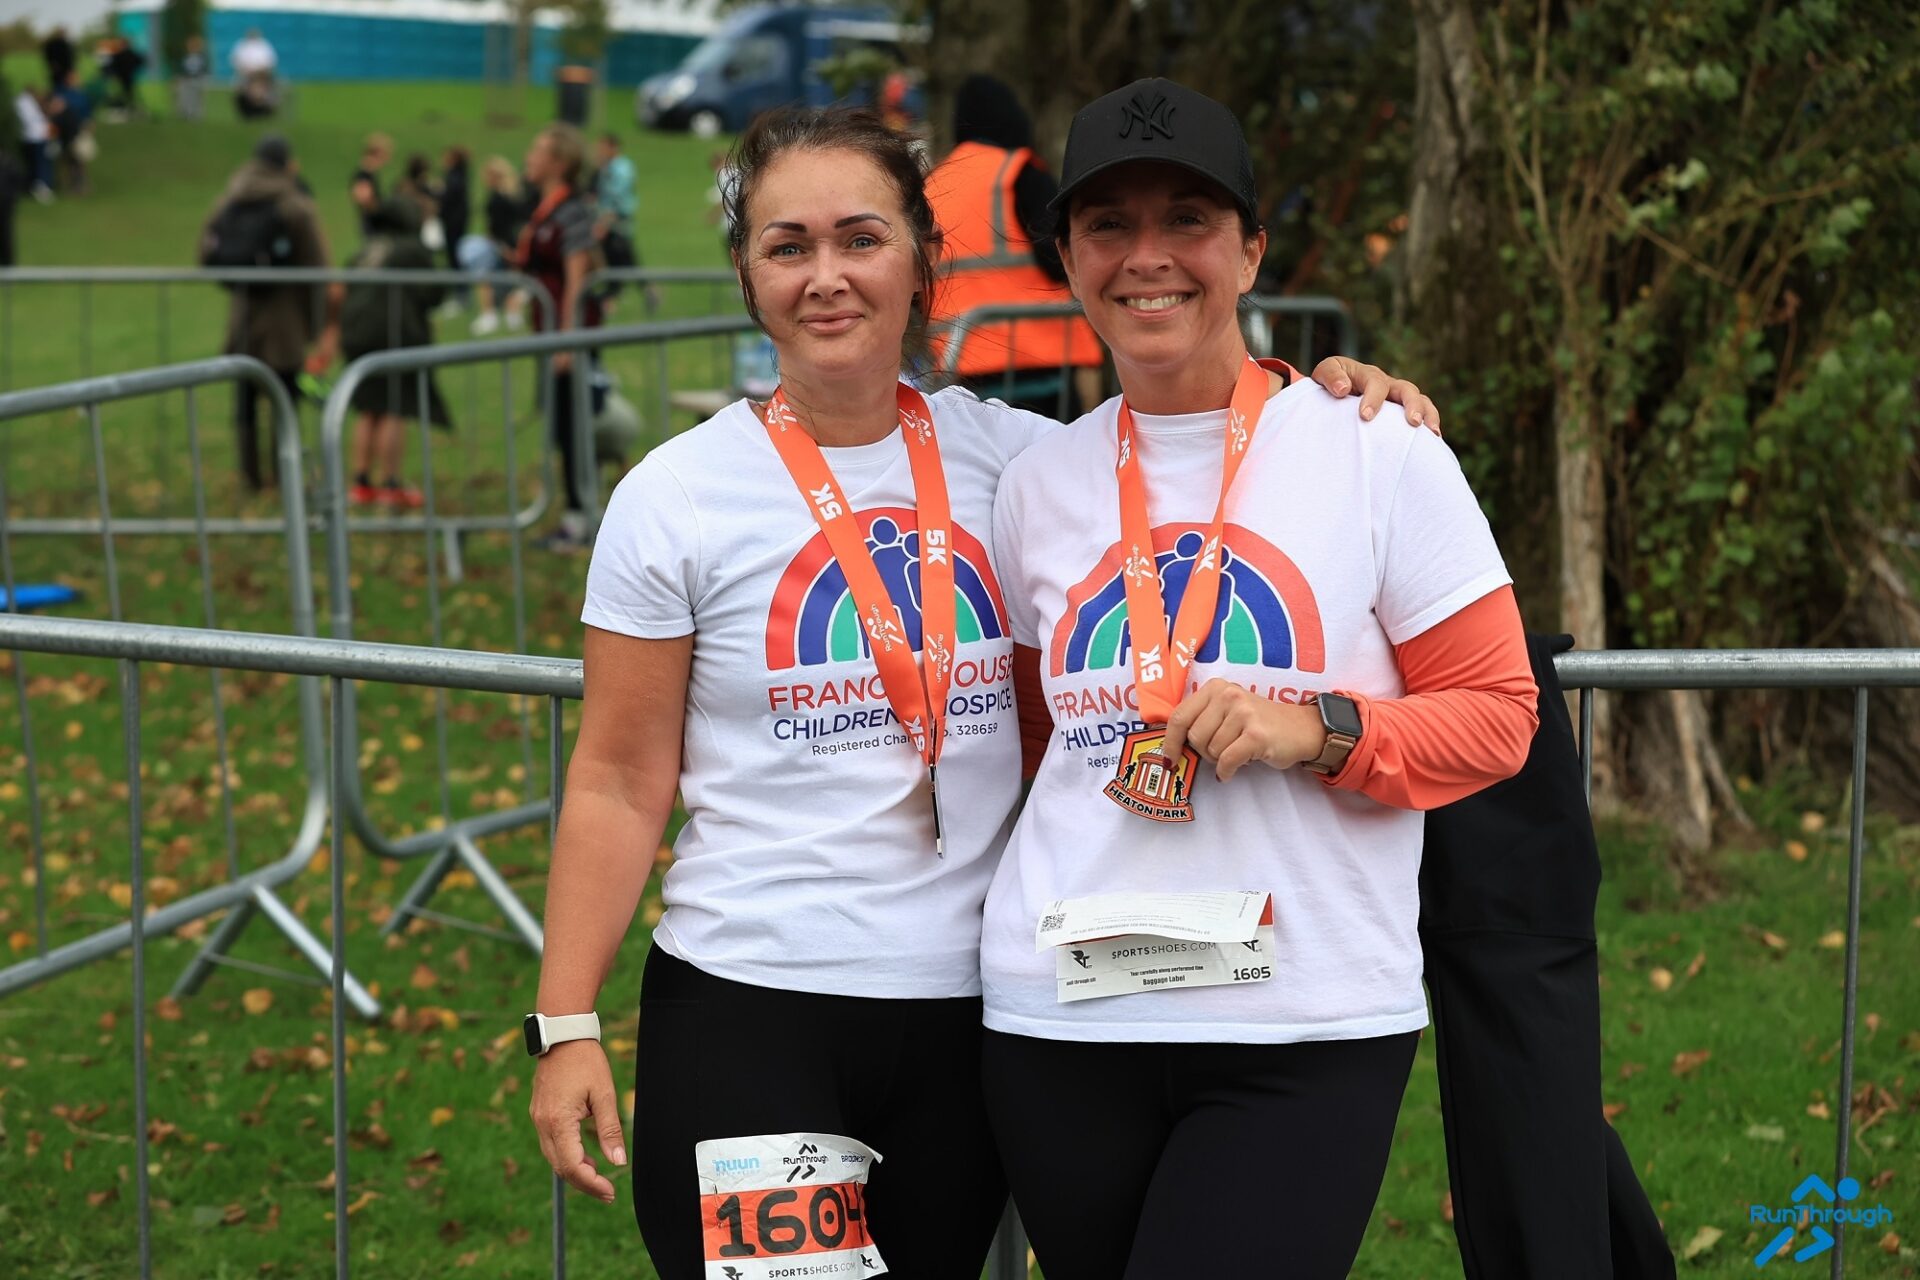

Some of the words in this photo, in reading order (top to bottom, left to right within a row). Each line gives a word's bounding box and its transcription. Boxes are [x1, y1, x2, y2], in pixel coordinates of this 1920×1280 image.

[1119, 91, 1176, 140] NY
[809, 482, 843, 521] 5K
[926, 528, 947, 566] 5K
[1195, 536, 1218, 575] 5K
[871, 603, 892, 653] RunThrough
[936, 633, 944, 683] RunThrough
[1139, 643, 1164, 683] 5K
[768, 673, 888, 712] FRANC
[954, 653, 1013, 688] OUSE
[1052, 684, 1140, 720] FRANC
[773, 707, 900, 741] CHILDREN
[812, 736, 880, 757] Registered
[956, 722, 998, 737] 328659
[1109, 785, 1154, 815] HEATON
[1156, 808, 1188, 818] PARK
[1142, 976, 1168, 986] Baggage
[1168, 974, 1186, 983] Label
[1233, 965, 1271, 981] 1605
[713, 1157, 760, 1172] nuun
[782, 1154, 829, 1166] RunThrough
[716, 1186, 865, 1258] 1604
